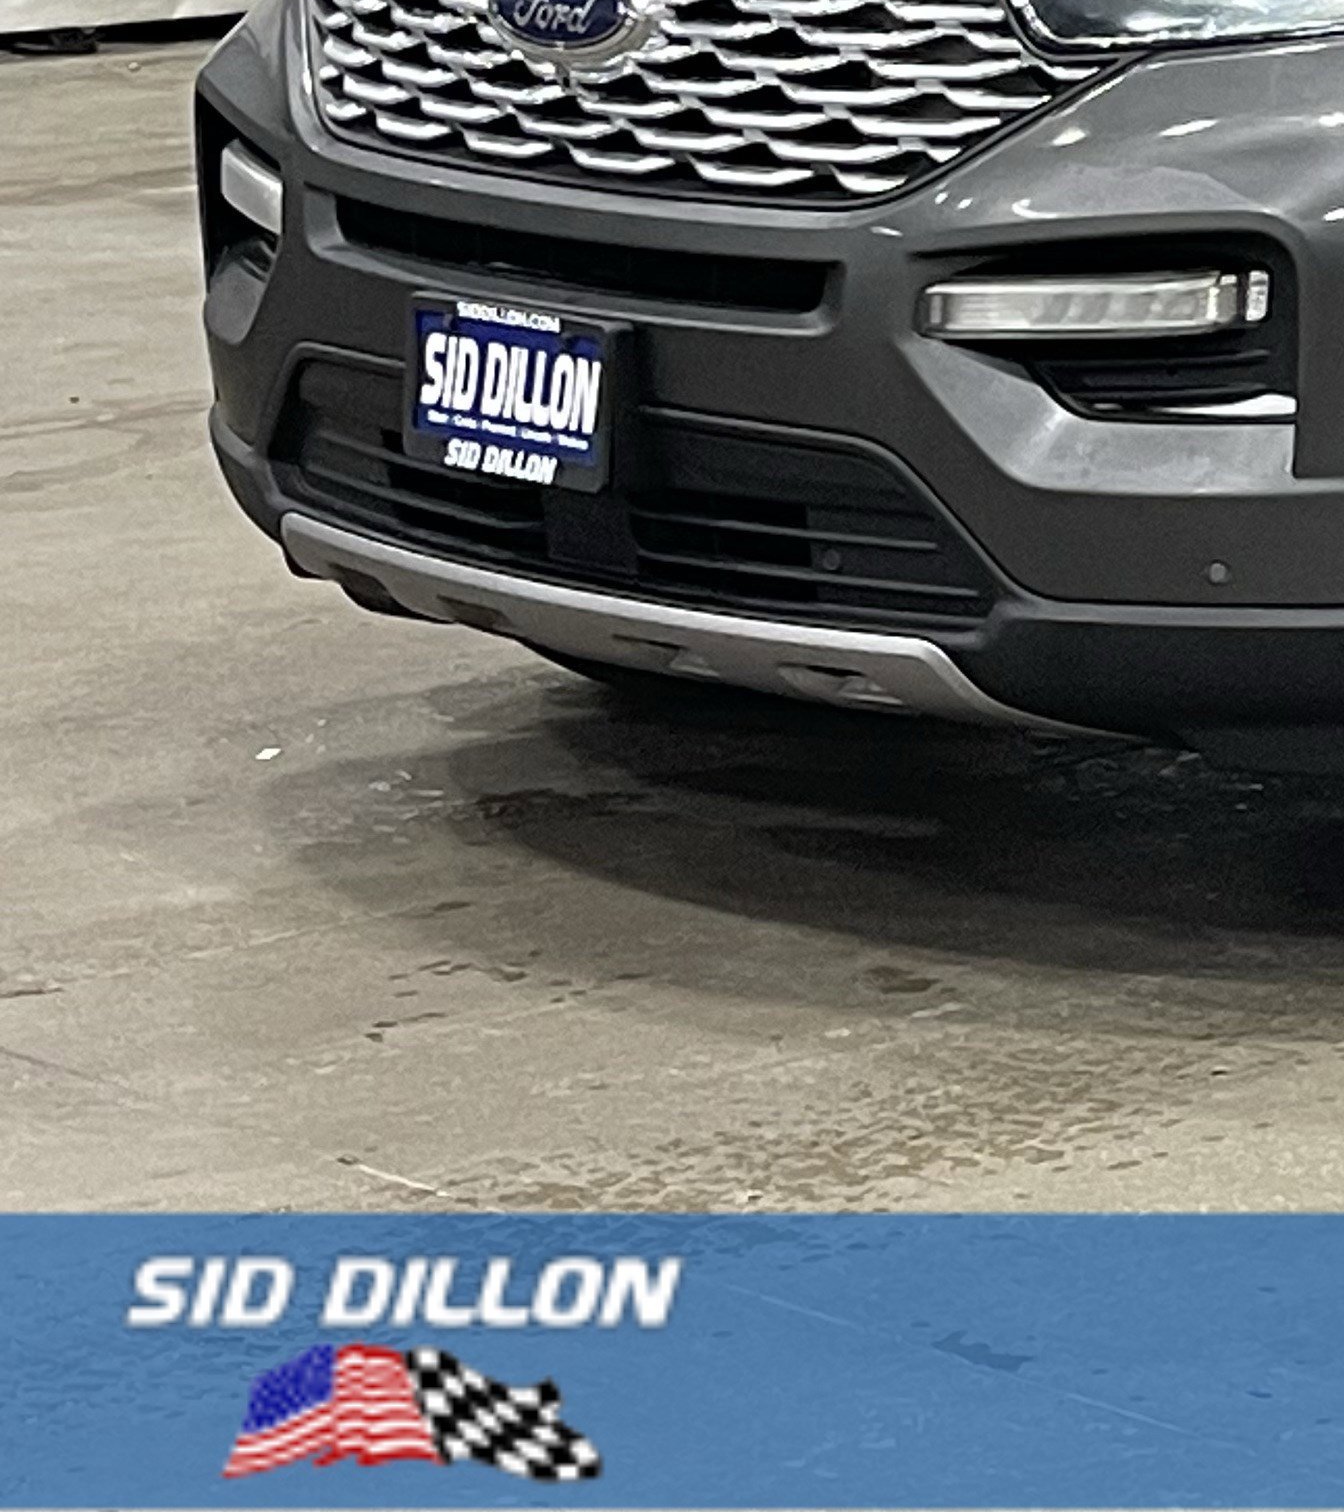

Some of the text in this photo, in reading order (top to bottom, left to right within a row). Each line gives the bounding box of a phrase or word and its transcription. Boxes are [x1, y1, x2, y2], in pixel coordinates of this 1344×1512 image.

[420, 332, 479, 411] SID
[480, 341, 602, 436] DILLON
[444, 438, 558, 485] SID DILLON
